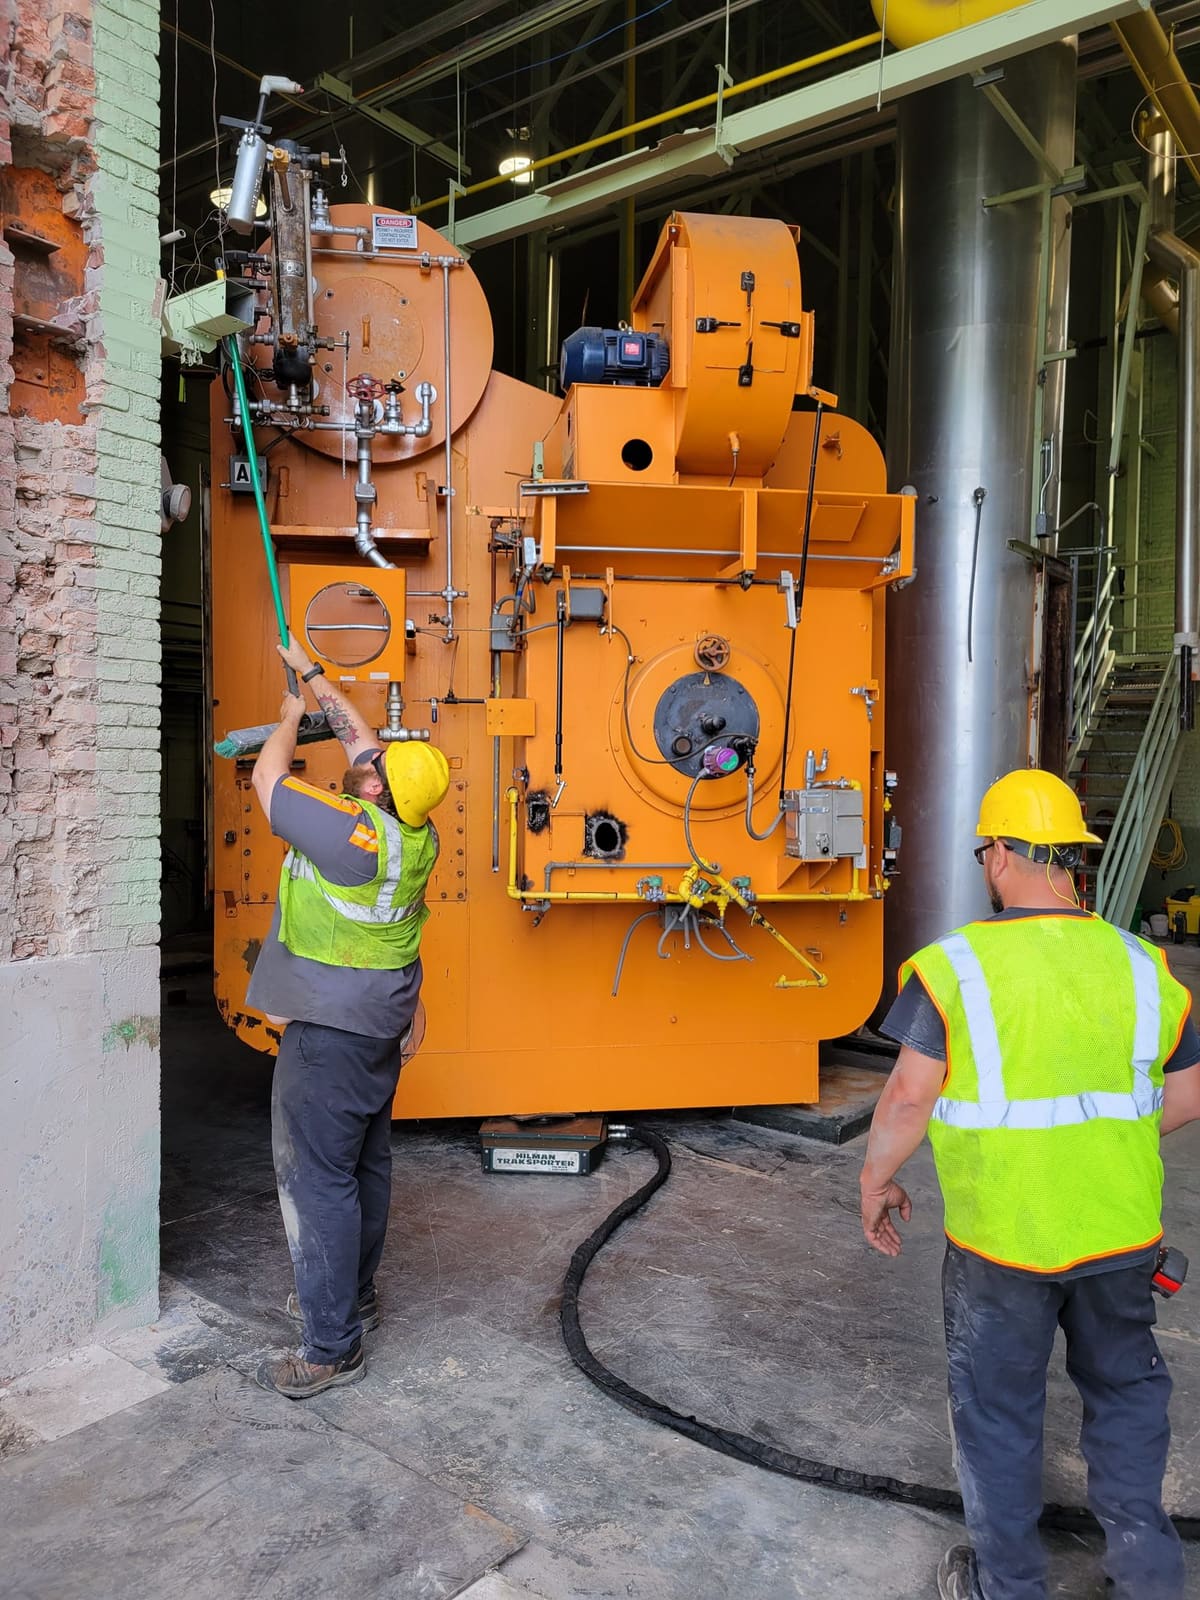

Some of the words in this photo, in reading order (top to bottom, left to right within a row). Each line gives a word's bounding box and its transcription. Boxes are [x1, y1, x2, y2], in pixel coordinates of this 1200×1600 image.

[381, 219, 408, 227] DANGER
[236, 463, 249, 481] A
[515, 1152, 556, 1160] HILMAN
[497, 1158, 575, 1167] TRAKSPORTER
